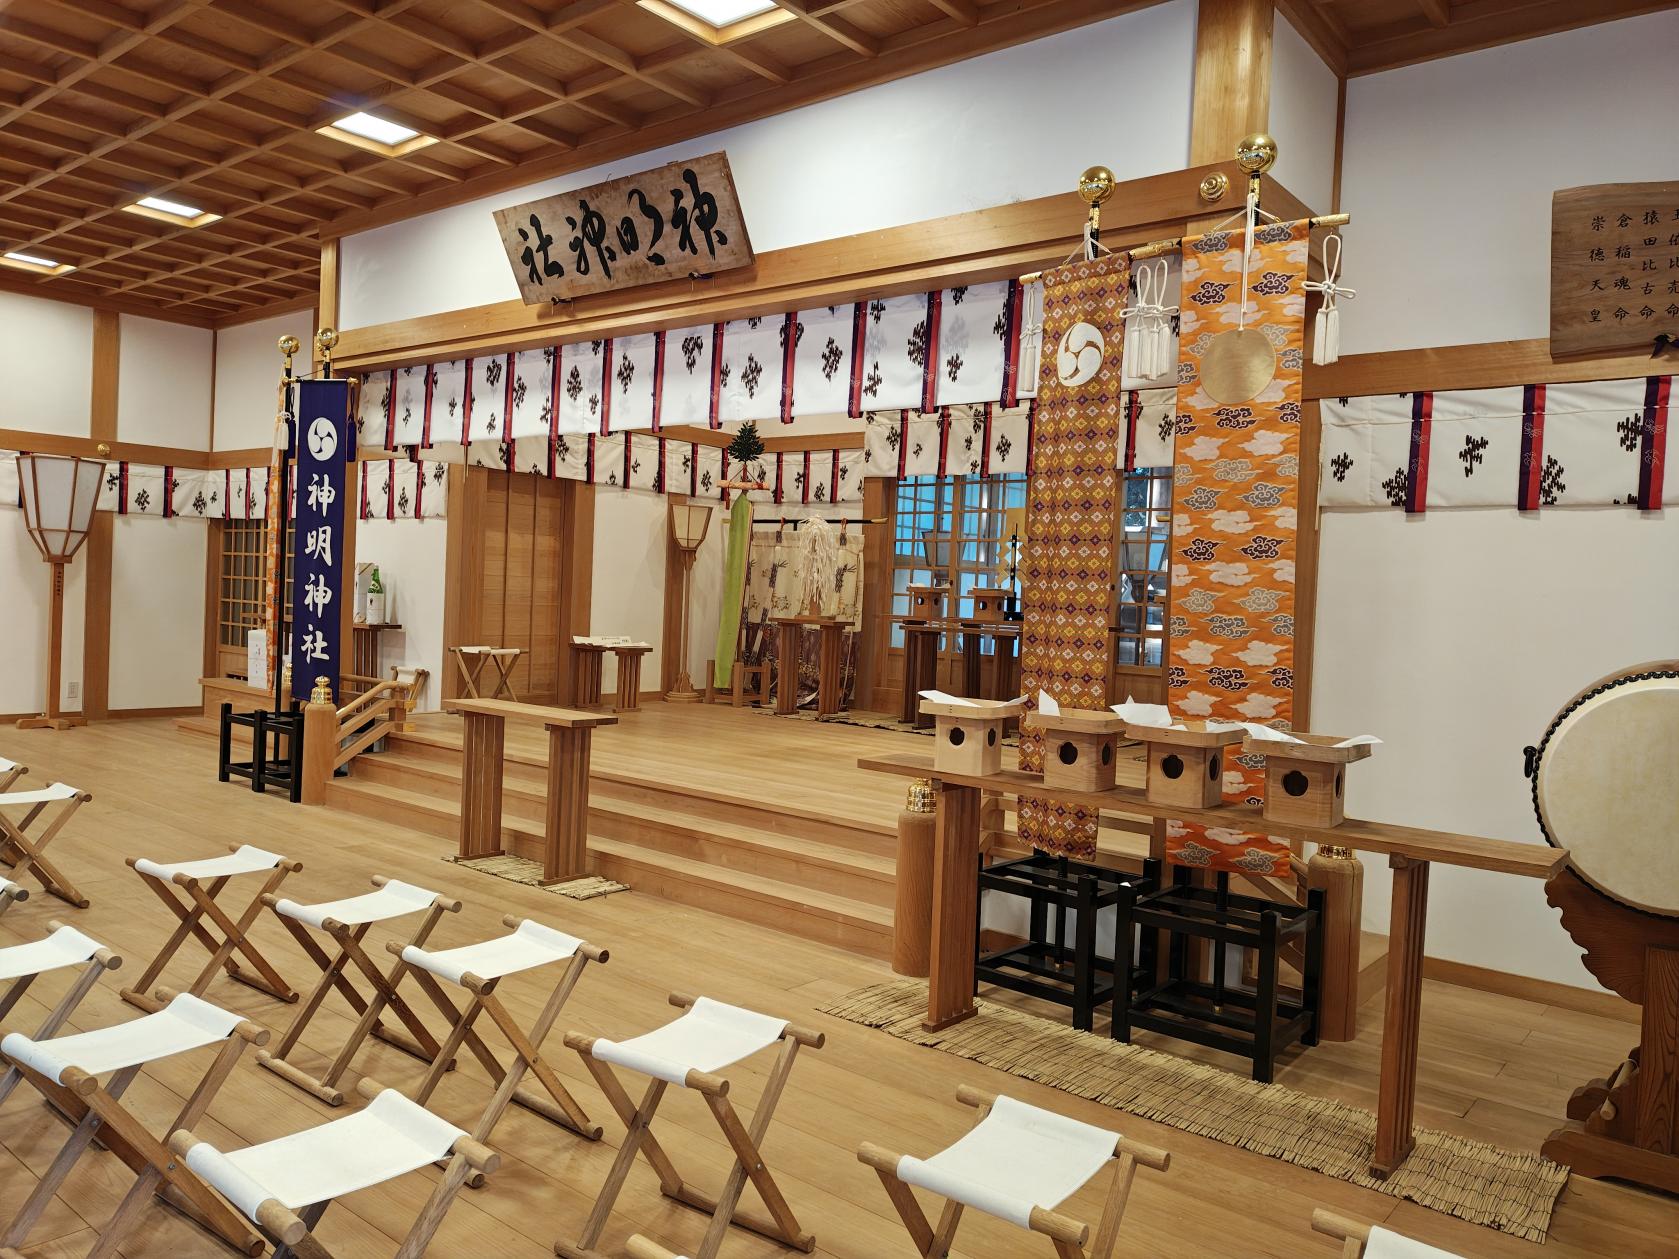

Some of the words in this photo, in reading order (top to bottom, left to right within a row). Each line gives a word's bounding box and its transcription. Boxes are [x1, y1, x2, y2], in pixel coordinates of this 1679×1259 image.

[1613, 213, 1633, 321] 倉稲魂命
[1639, 209, 1661, 320] 猿田比古命
[300, 473, 336, 664] 神明神社
